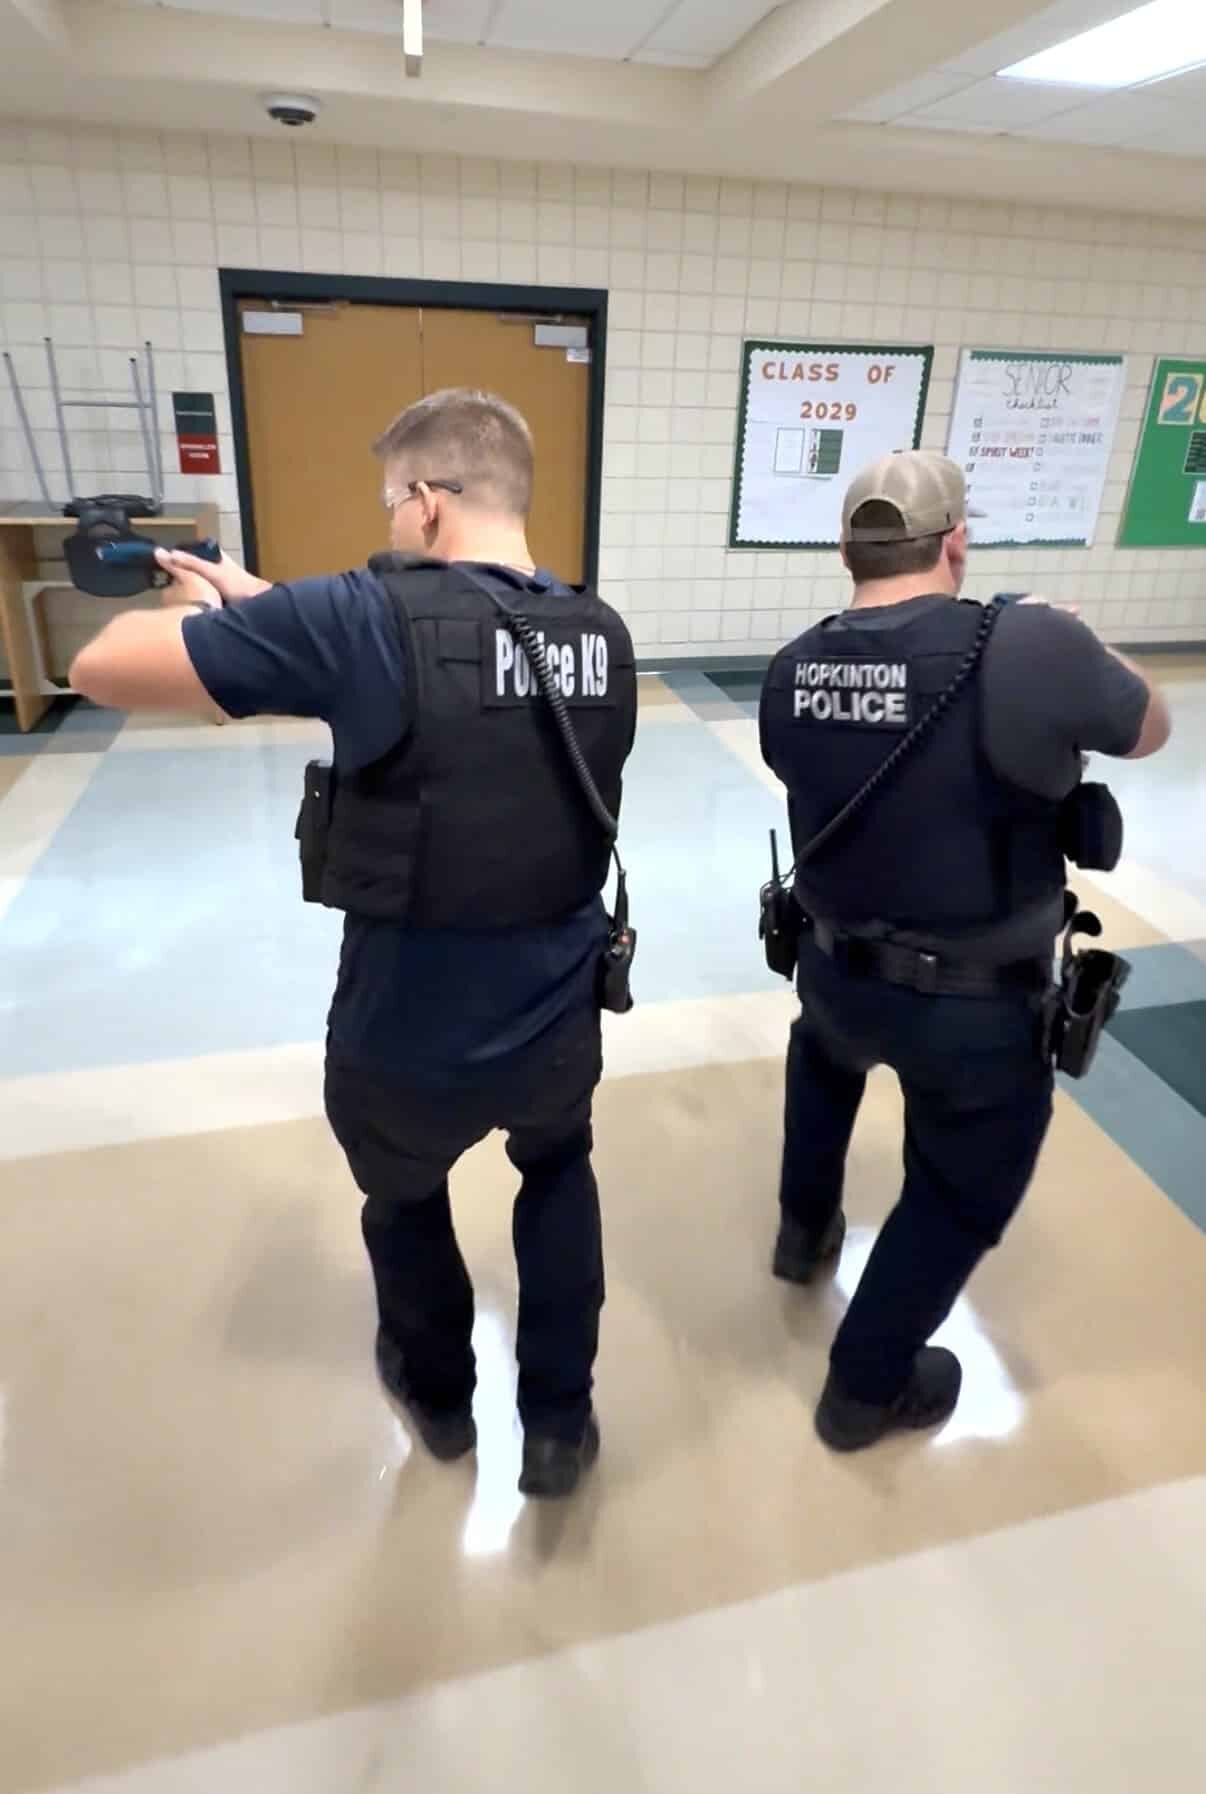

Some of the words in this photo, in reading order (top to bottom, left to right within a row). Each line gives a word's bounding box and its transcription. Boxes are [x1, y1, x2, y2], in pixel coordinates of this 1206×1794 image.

[762, 362, 840, 382] CLASS
[867, 365, 896, 384] OF
[1003, 363, 1073, 396] SENIOR
[800, 401, 857, 420] 2029
[581, 633, 608, 697] K9
[795, 663, 906, 688] HOPKINTON
[794, 689, 907, 722] POLICE
